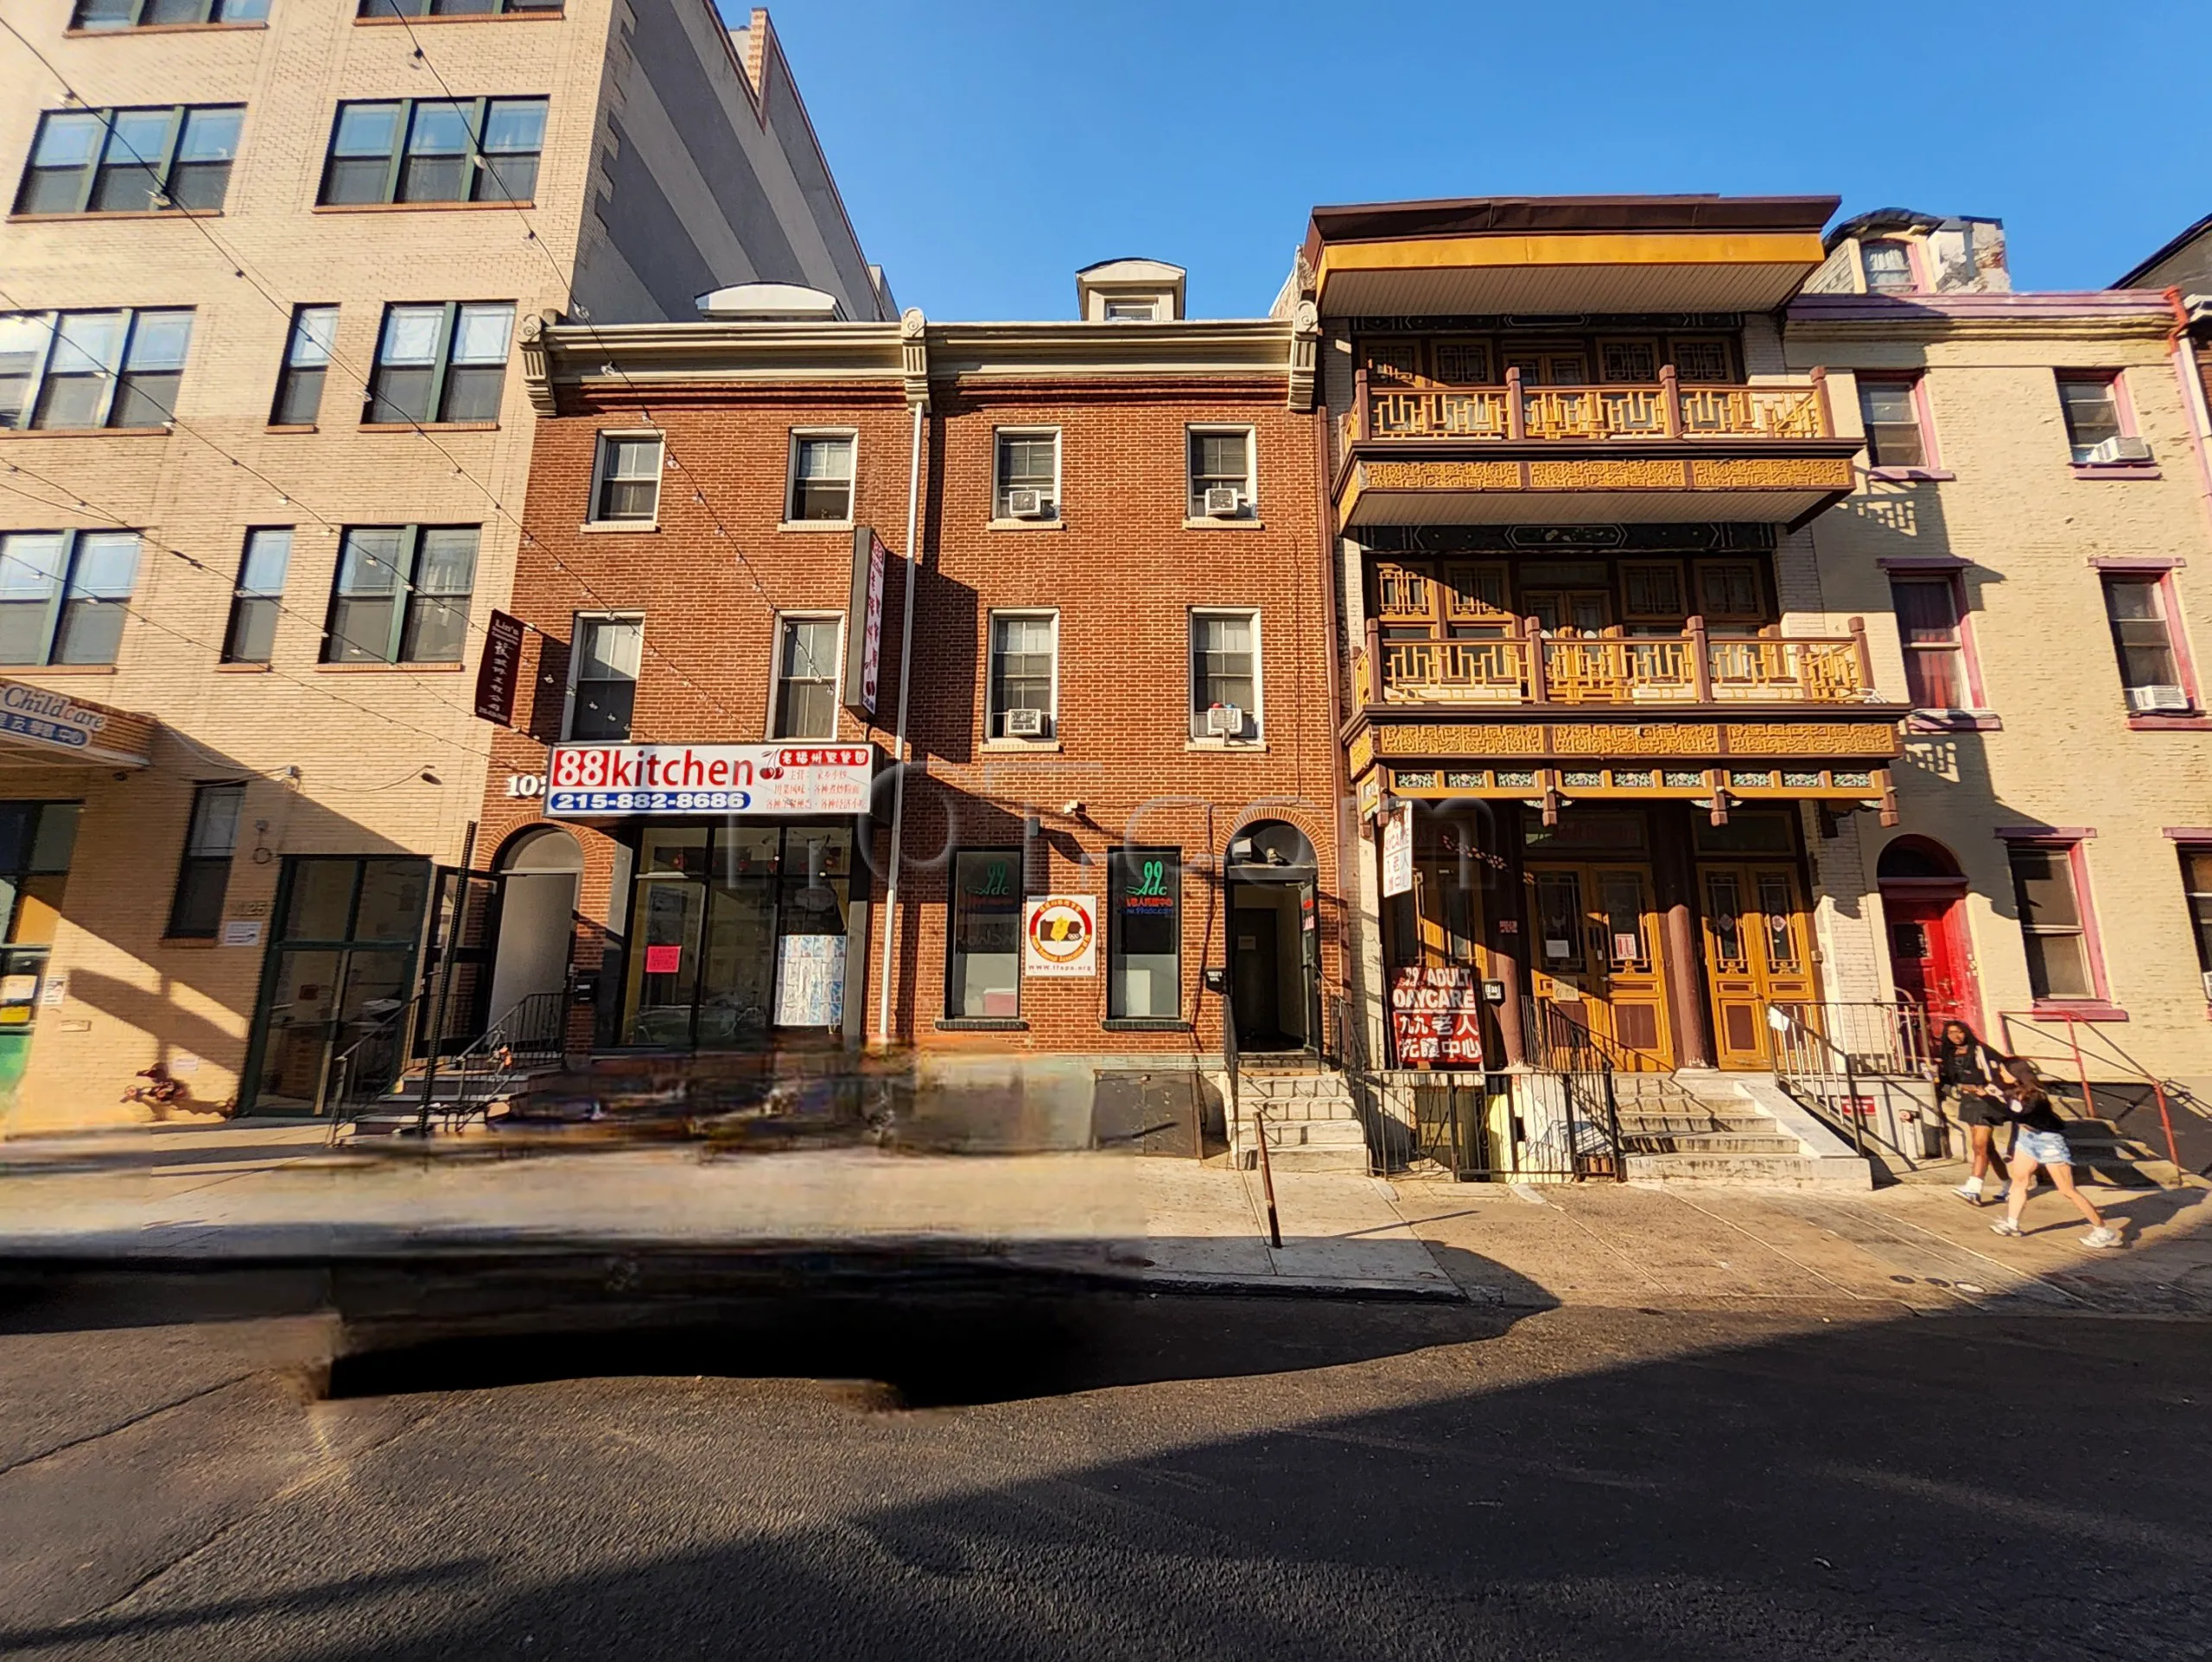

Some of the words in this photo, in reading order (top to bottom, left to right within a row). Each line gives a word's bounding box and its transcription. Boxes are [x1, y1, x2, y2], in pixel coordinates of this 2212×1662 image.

[4, 686, 105, 728] Childcare
[557, 750, 607, 786] 88
[612, 749, 754, 786] kitchen
[556, 793, 745, 809] 215-882-8686
[1427, 968, 1471, 987] ADULT
[1392, 988, 1476, 1009] DAYCARE
[1399, 1015, 1479, 1035] 九九老人
